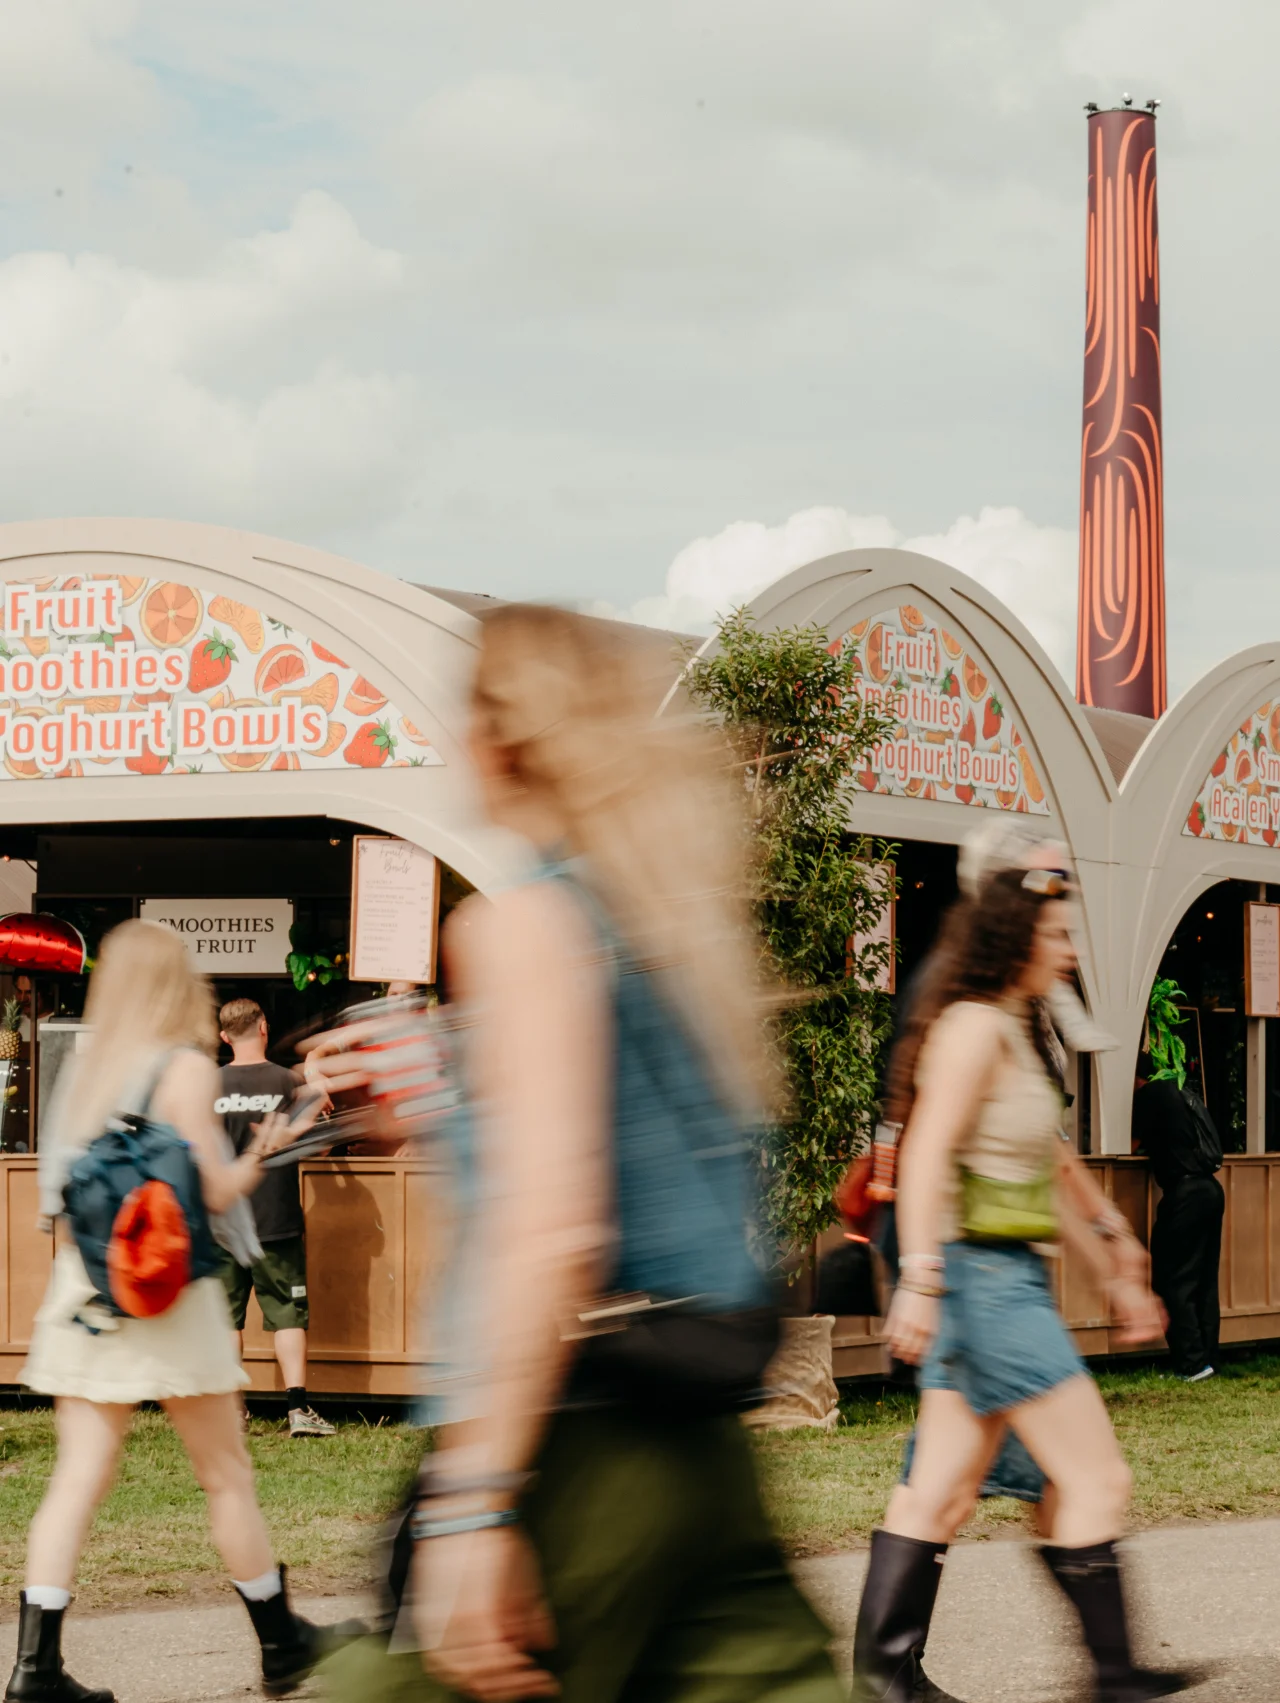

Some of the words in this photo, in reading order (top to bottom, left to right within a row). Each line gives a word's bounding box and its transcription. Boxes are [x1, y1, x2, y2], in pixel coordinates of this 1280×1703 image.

[10, 587, 117, 631] Fruit
[884, 631, 933, 672] Fruit
[183, 703, 322, 749] Bowls
[872, 737, 953, 782] Yoghurt
[959, 747, 1018, 787] Bowls
[1212, 788, 1246, 821] Acai
[1250, 800, 1267, 825] en
[195, 939, 257, 954] FRUIT
[213, 1093, 285, 1115] obey
